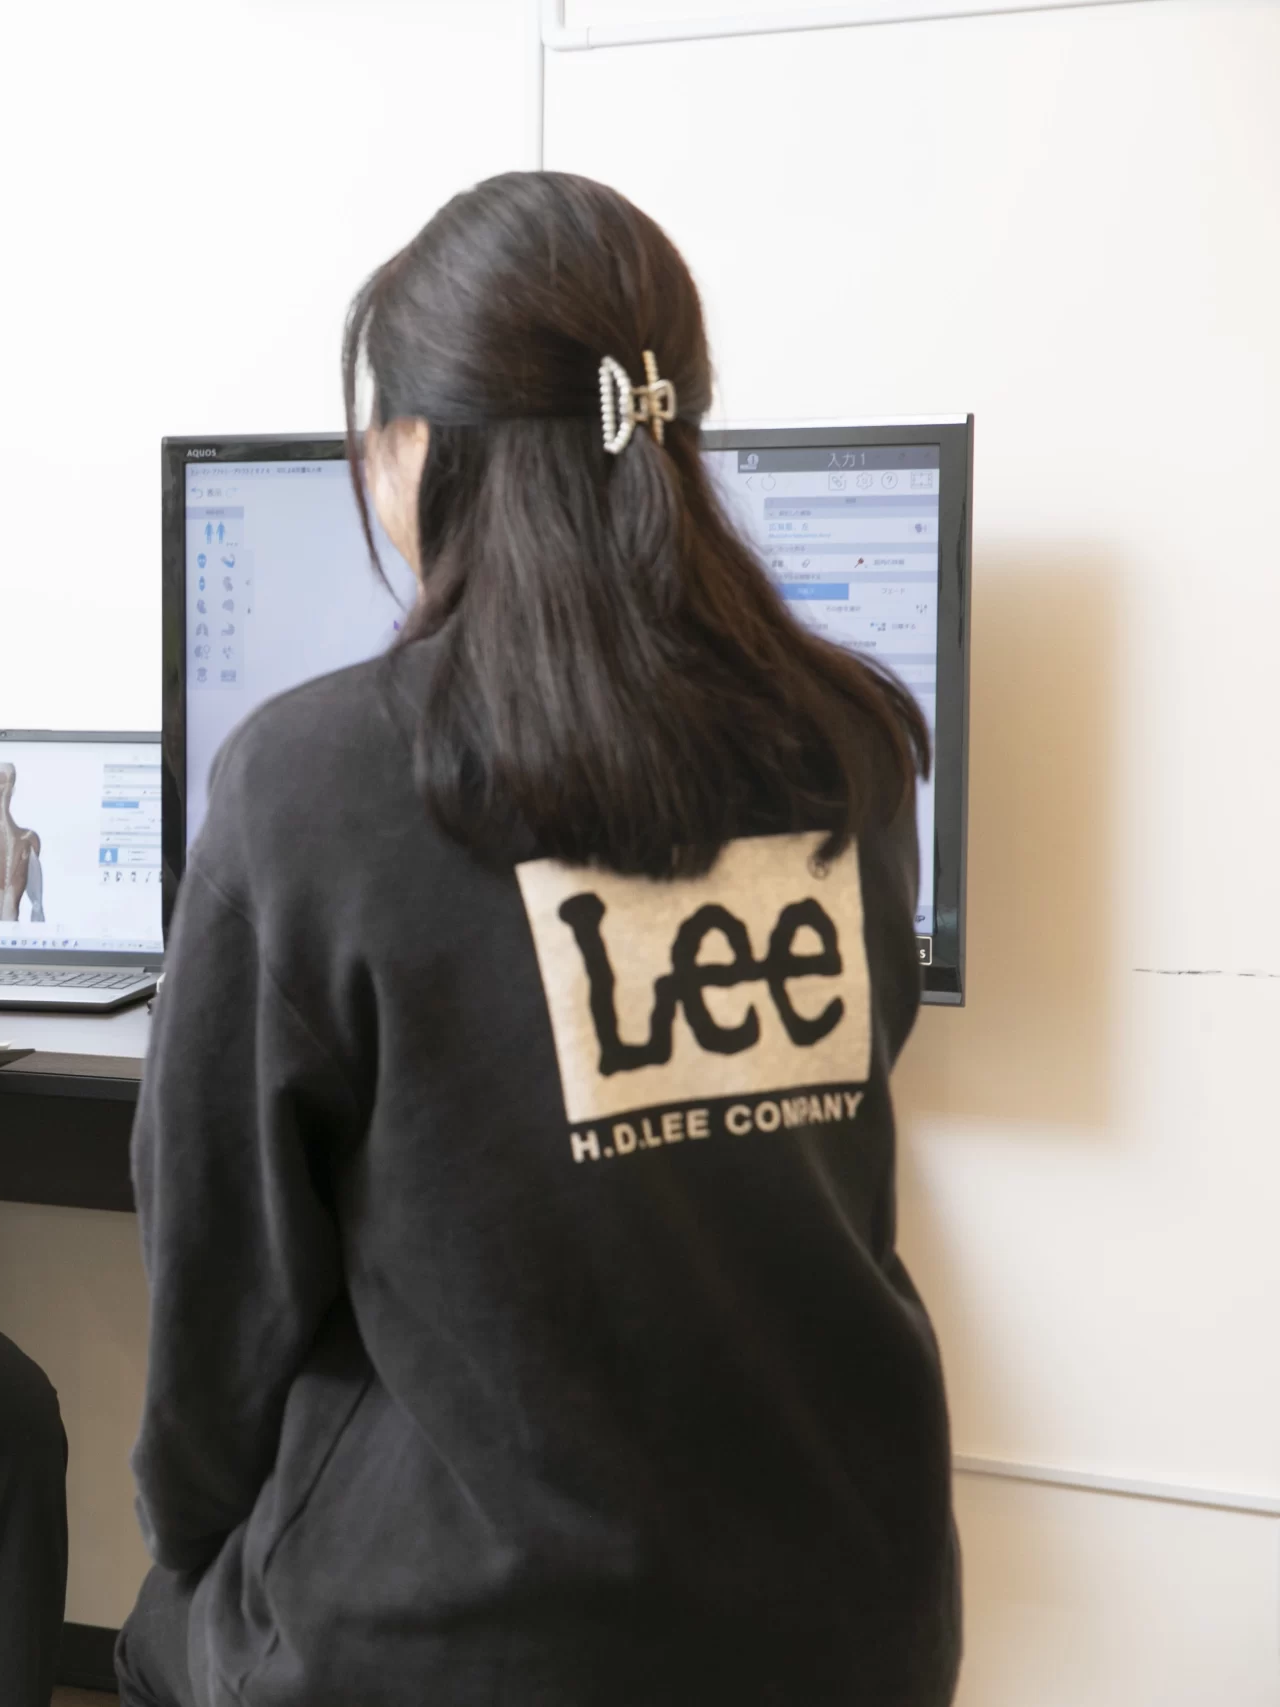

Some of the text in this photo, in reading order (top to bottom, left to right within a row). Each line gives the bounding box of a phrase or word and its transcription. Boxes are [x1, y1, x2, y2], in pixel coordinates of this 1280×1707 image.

[186, 448, 217, 457] AQUOS
[558, 892, 844, 1077] Lee
[570, 1091, 863, 1164] H.D.LEE COMPANY
